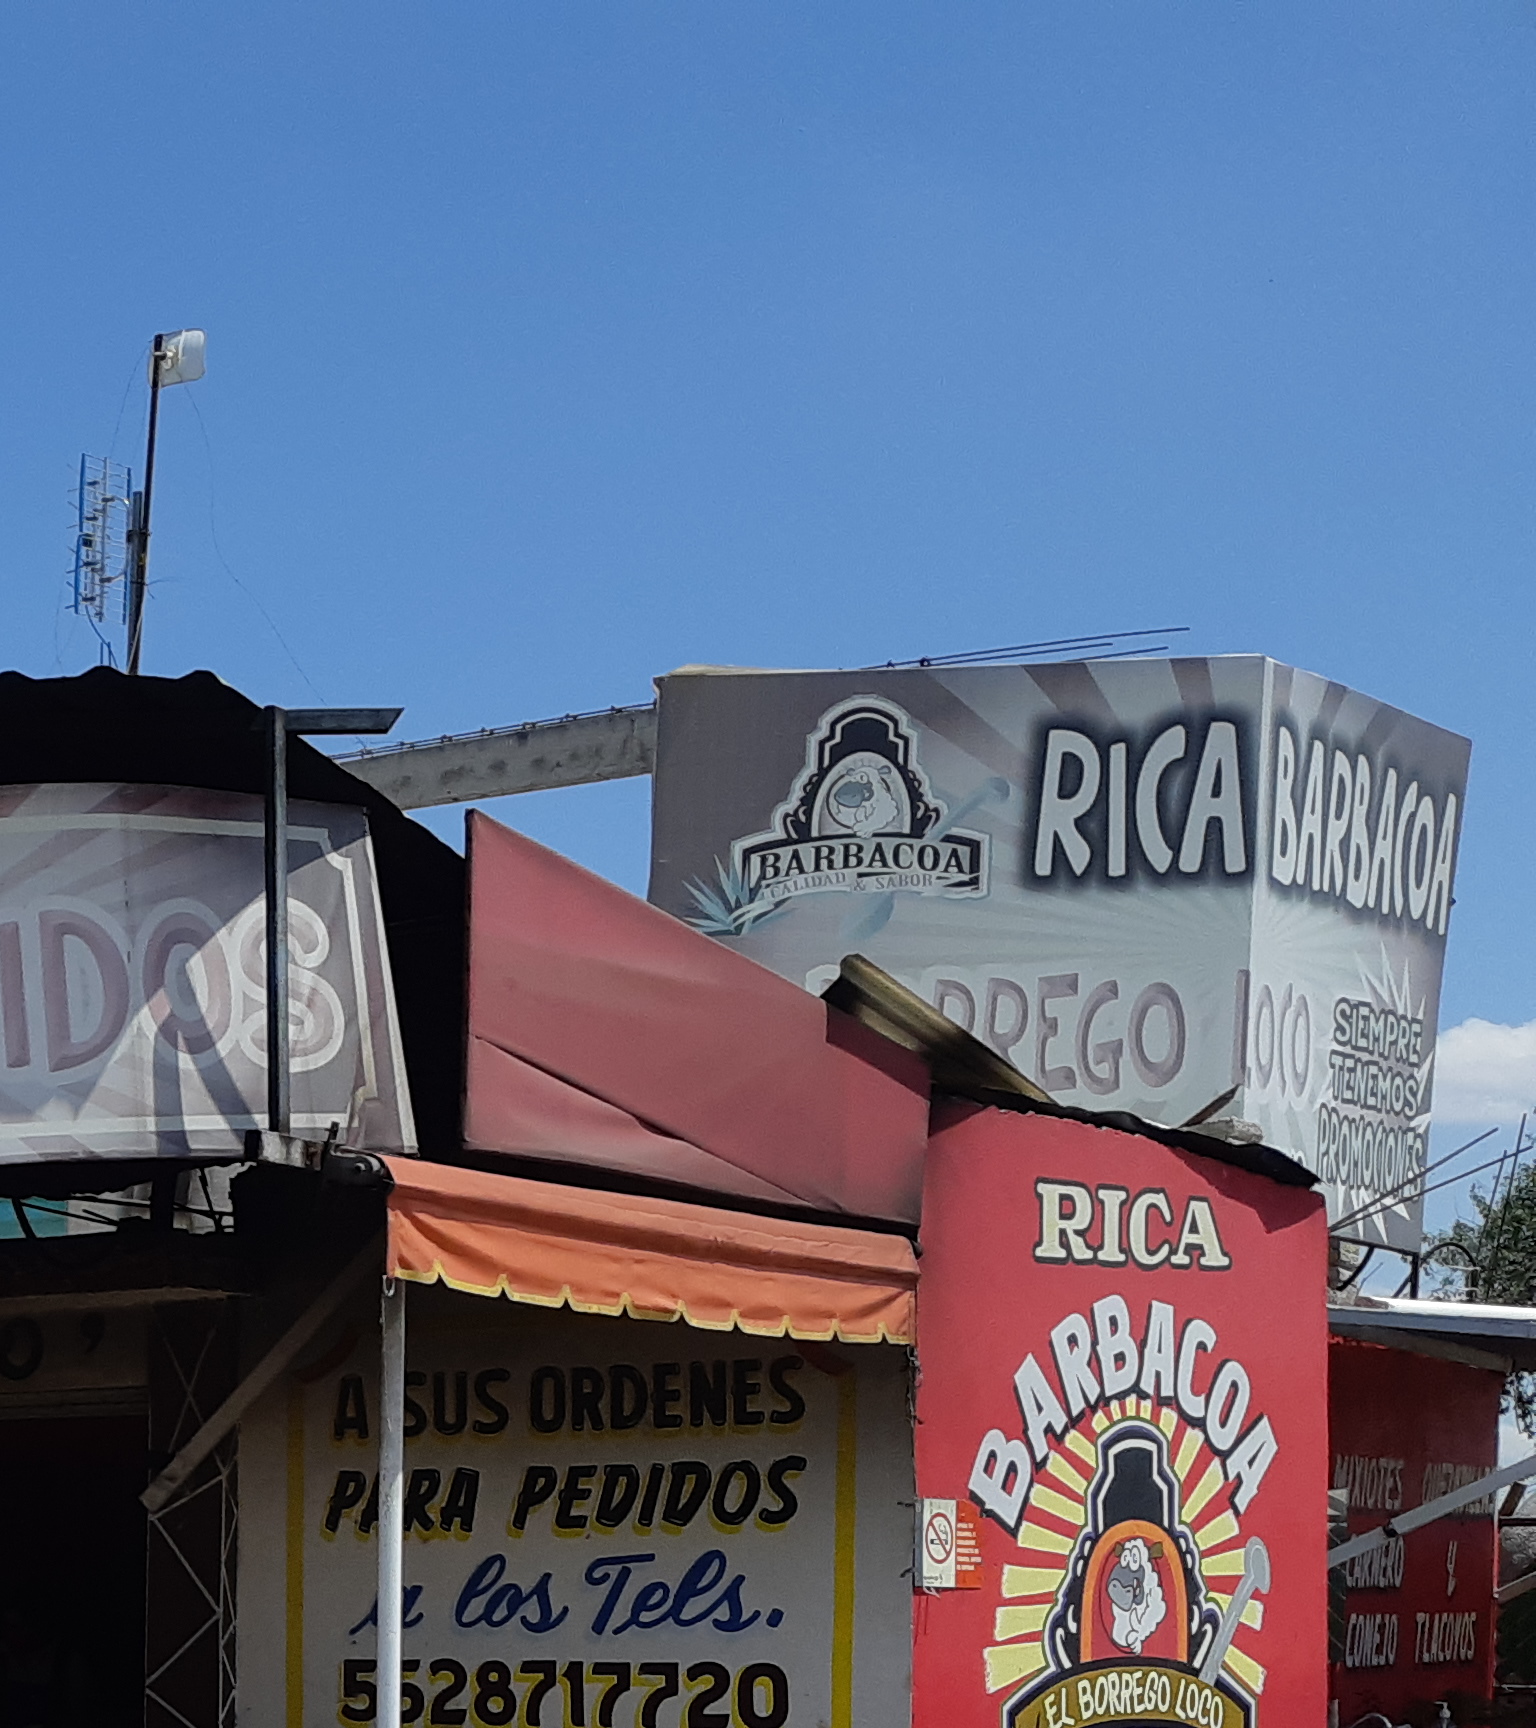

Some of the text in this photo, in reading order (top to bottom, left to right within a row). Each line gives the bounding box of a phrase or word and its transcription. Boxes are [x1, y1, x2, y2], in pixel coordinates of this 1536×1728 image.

[1034, 721, 1247, 877] RICA
[1272, 726, 1456, 936] BARBACOA
[757, 842, 968, 881] BARBACOA
[768, 872, 934, 900] CALIDAD & SABOR
[1333, 997, 1423, 1067] SIEMPRE
[1329, 1049, 1420, 1118] TENEMOS
[1317, 1102, 1424, 1201] PROMOCIONES
[1034, 1176, 1232, 1271] RICA
[334, 1354, 806, 1440] A SUS ORDENES
[967, 1294, 1278, 1534] BARBACOA
[511, 1454, 808, 1531] PEDIDOS
[455, 1553, 569, 1635] los
[584, 1549, 785, 1636] Tels.
[1345, 1612, 1399, 1669] CONEJO
[1414, 1611, 1477, 1664] TLACOYOS
[1078, 1670, 1171, 1721] BORREGO
